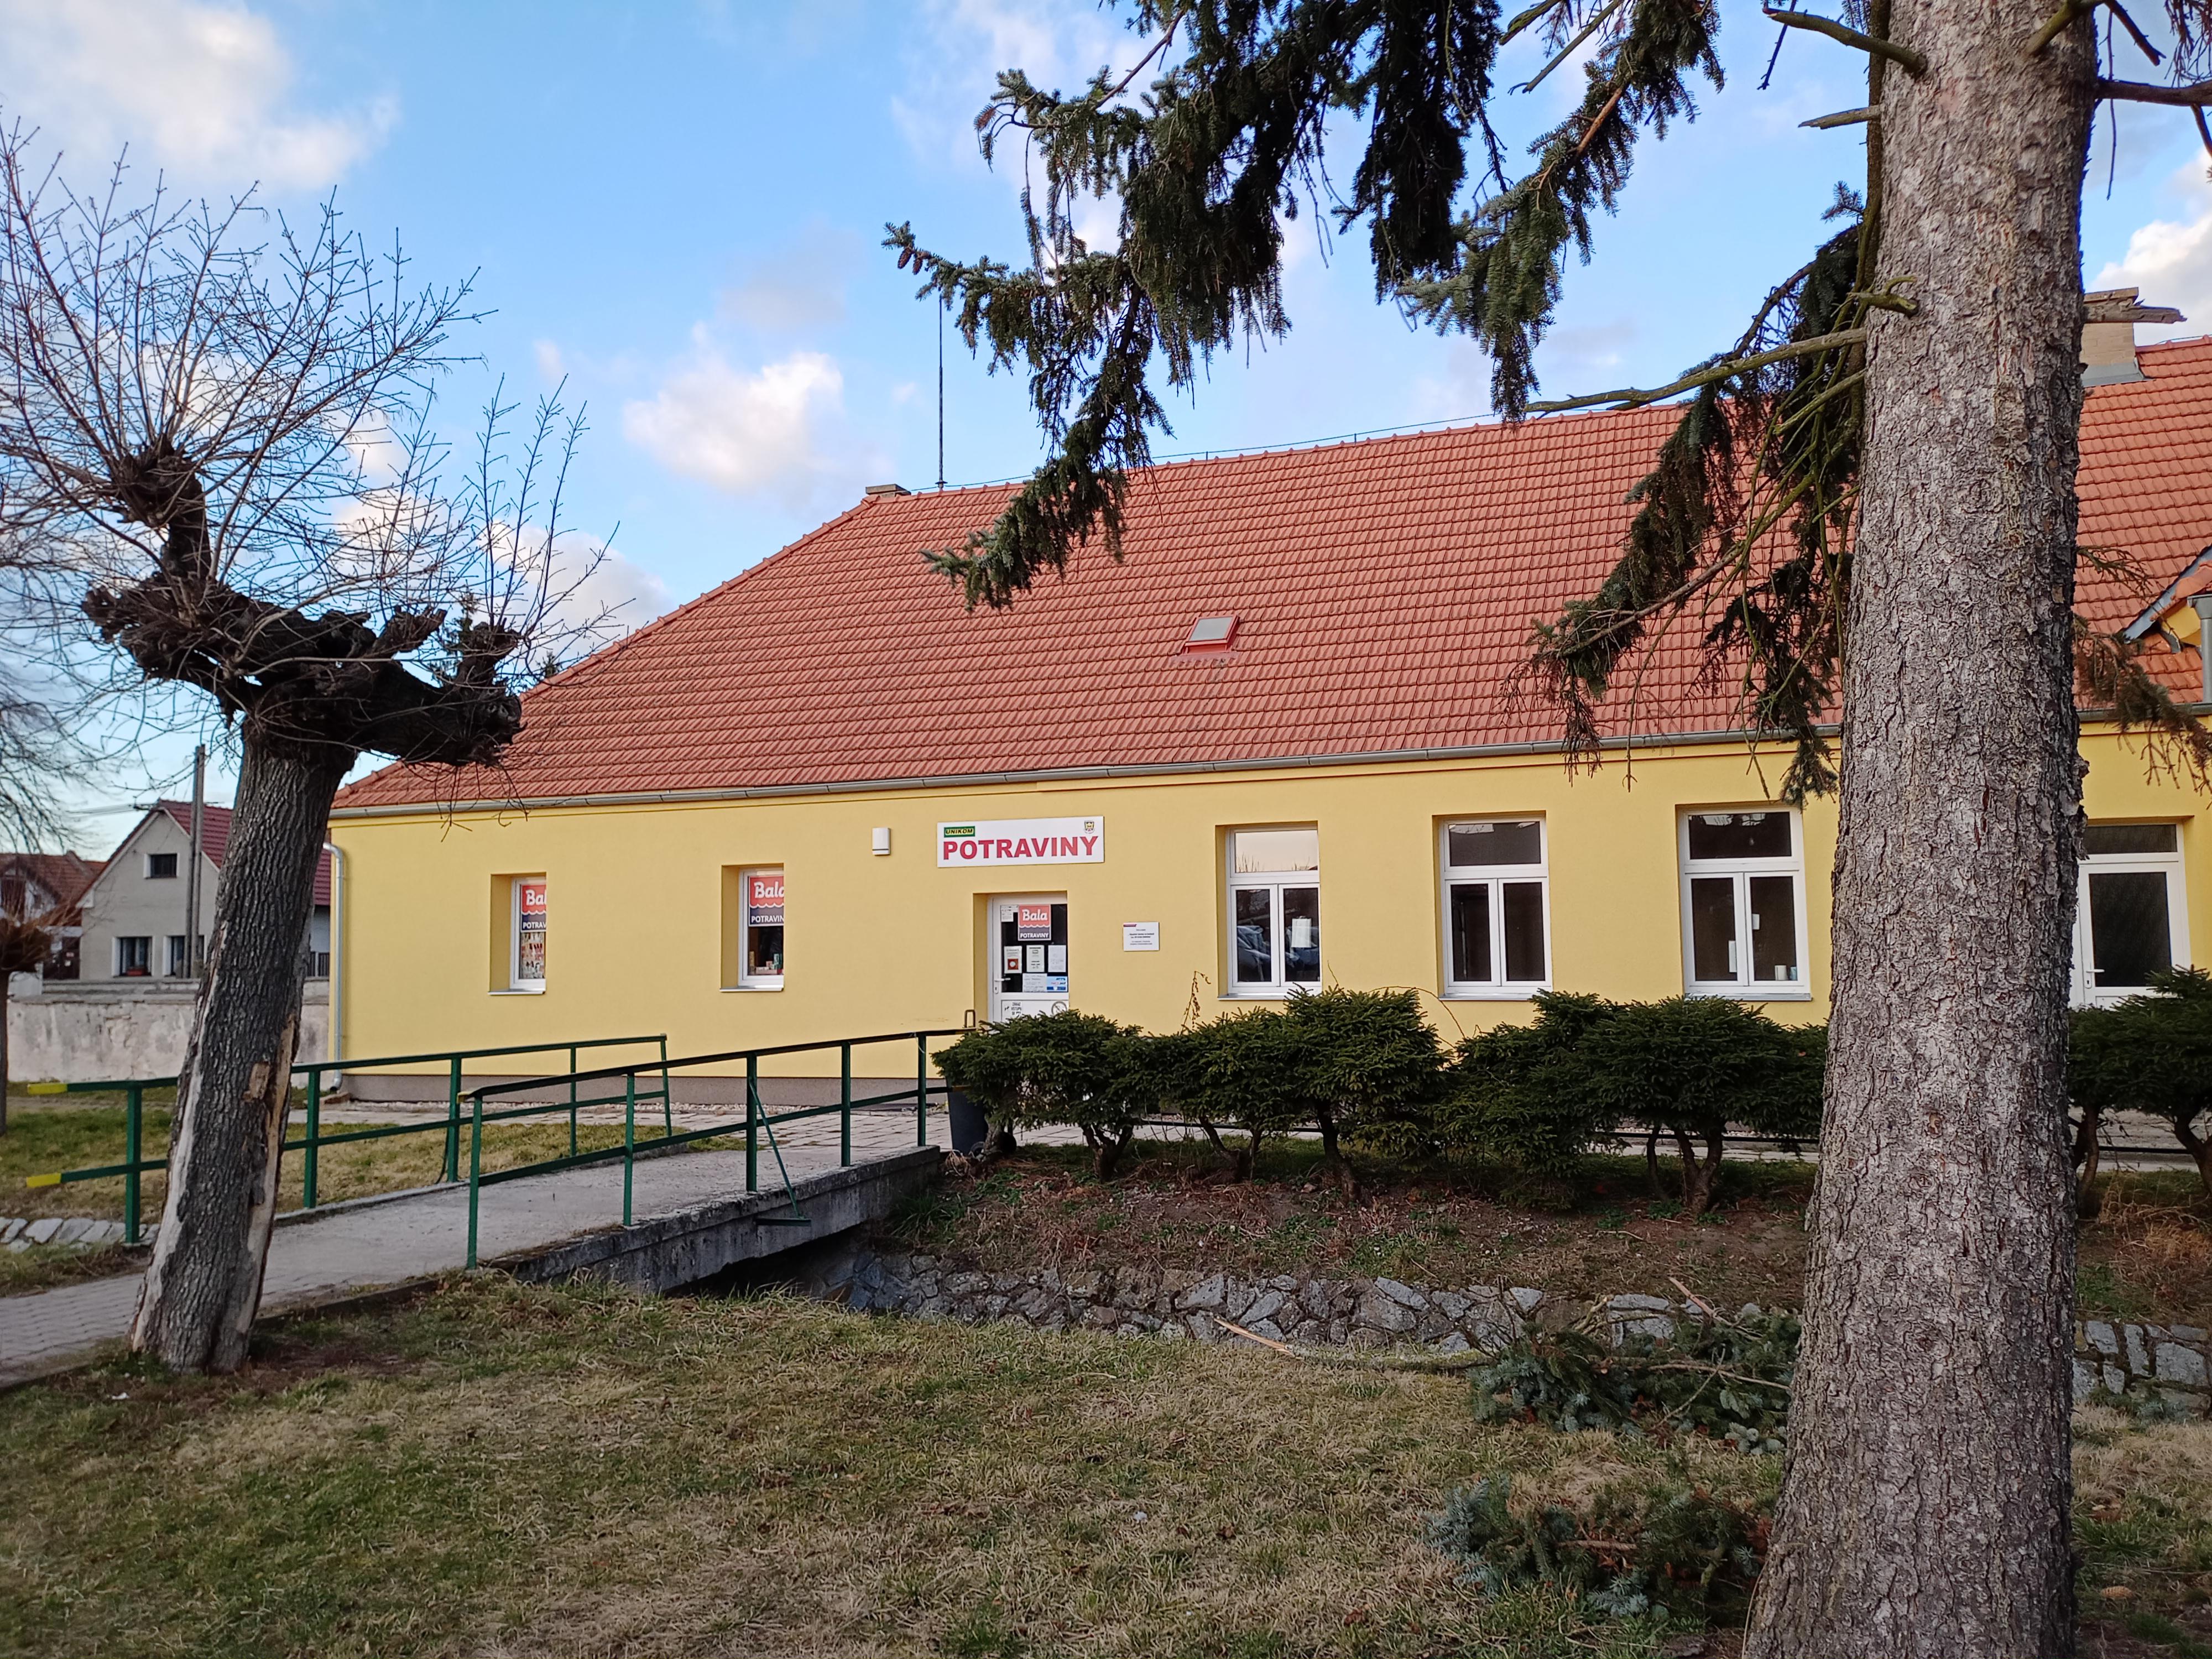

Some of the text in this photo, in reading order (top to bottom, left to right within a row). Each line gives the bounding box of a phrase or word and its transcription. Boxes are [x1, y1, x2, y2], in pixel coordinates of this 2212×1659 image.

[943, 836, 1098, 860] POTRAVINY
[525, 889, 547, 906] Bal
[1022, 909, 1048, 921] Bala
